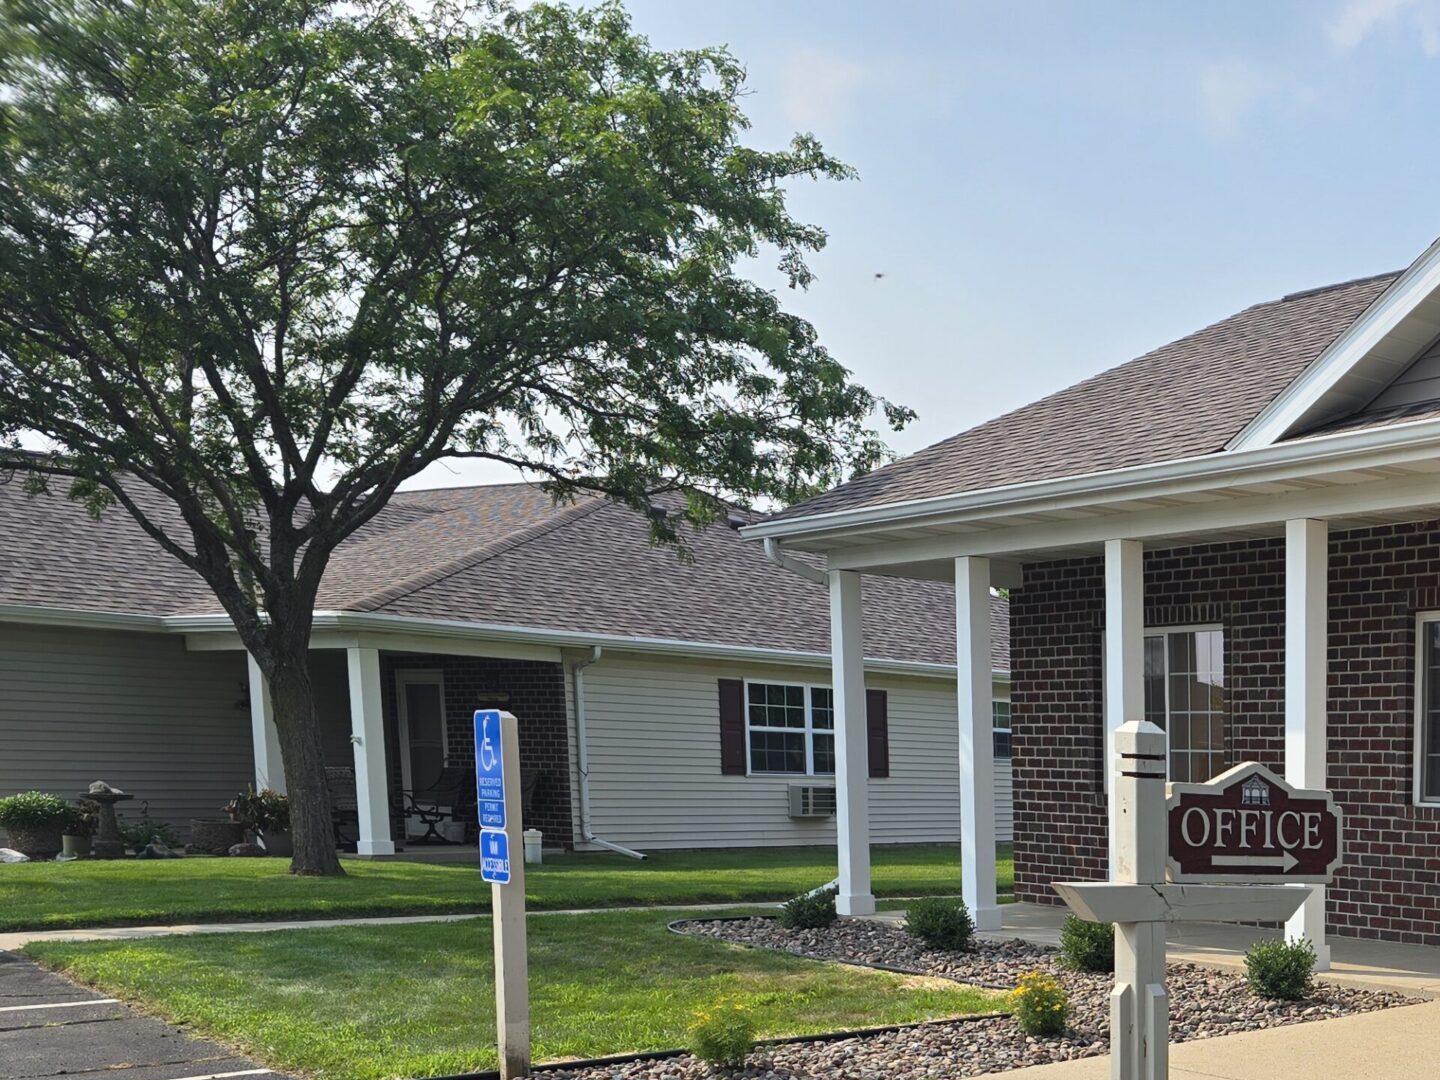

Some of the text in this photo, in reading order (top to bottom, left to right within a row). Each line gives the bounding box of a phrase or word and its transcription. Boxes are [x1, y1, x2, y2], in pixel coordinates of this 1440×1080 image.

[479, 777, 502, 787] RESERVED
[481, 788, 500, 798] PARKING
[1181, 807, 1324, 850] OFFICE
